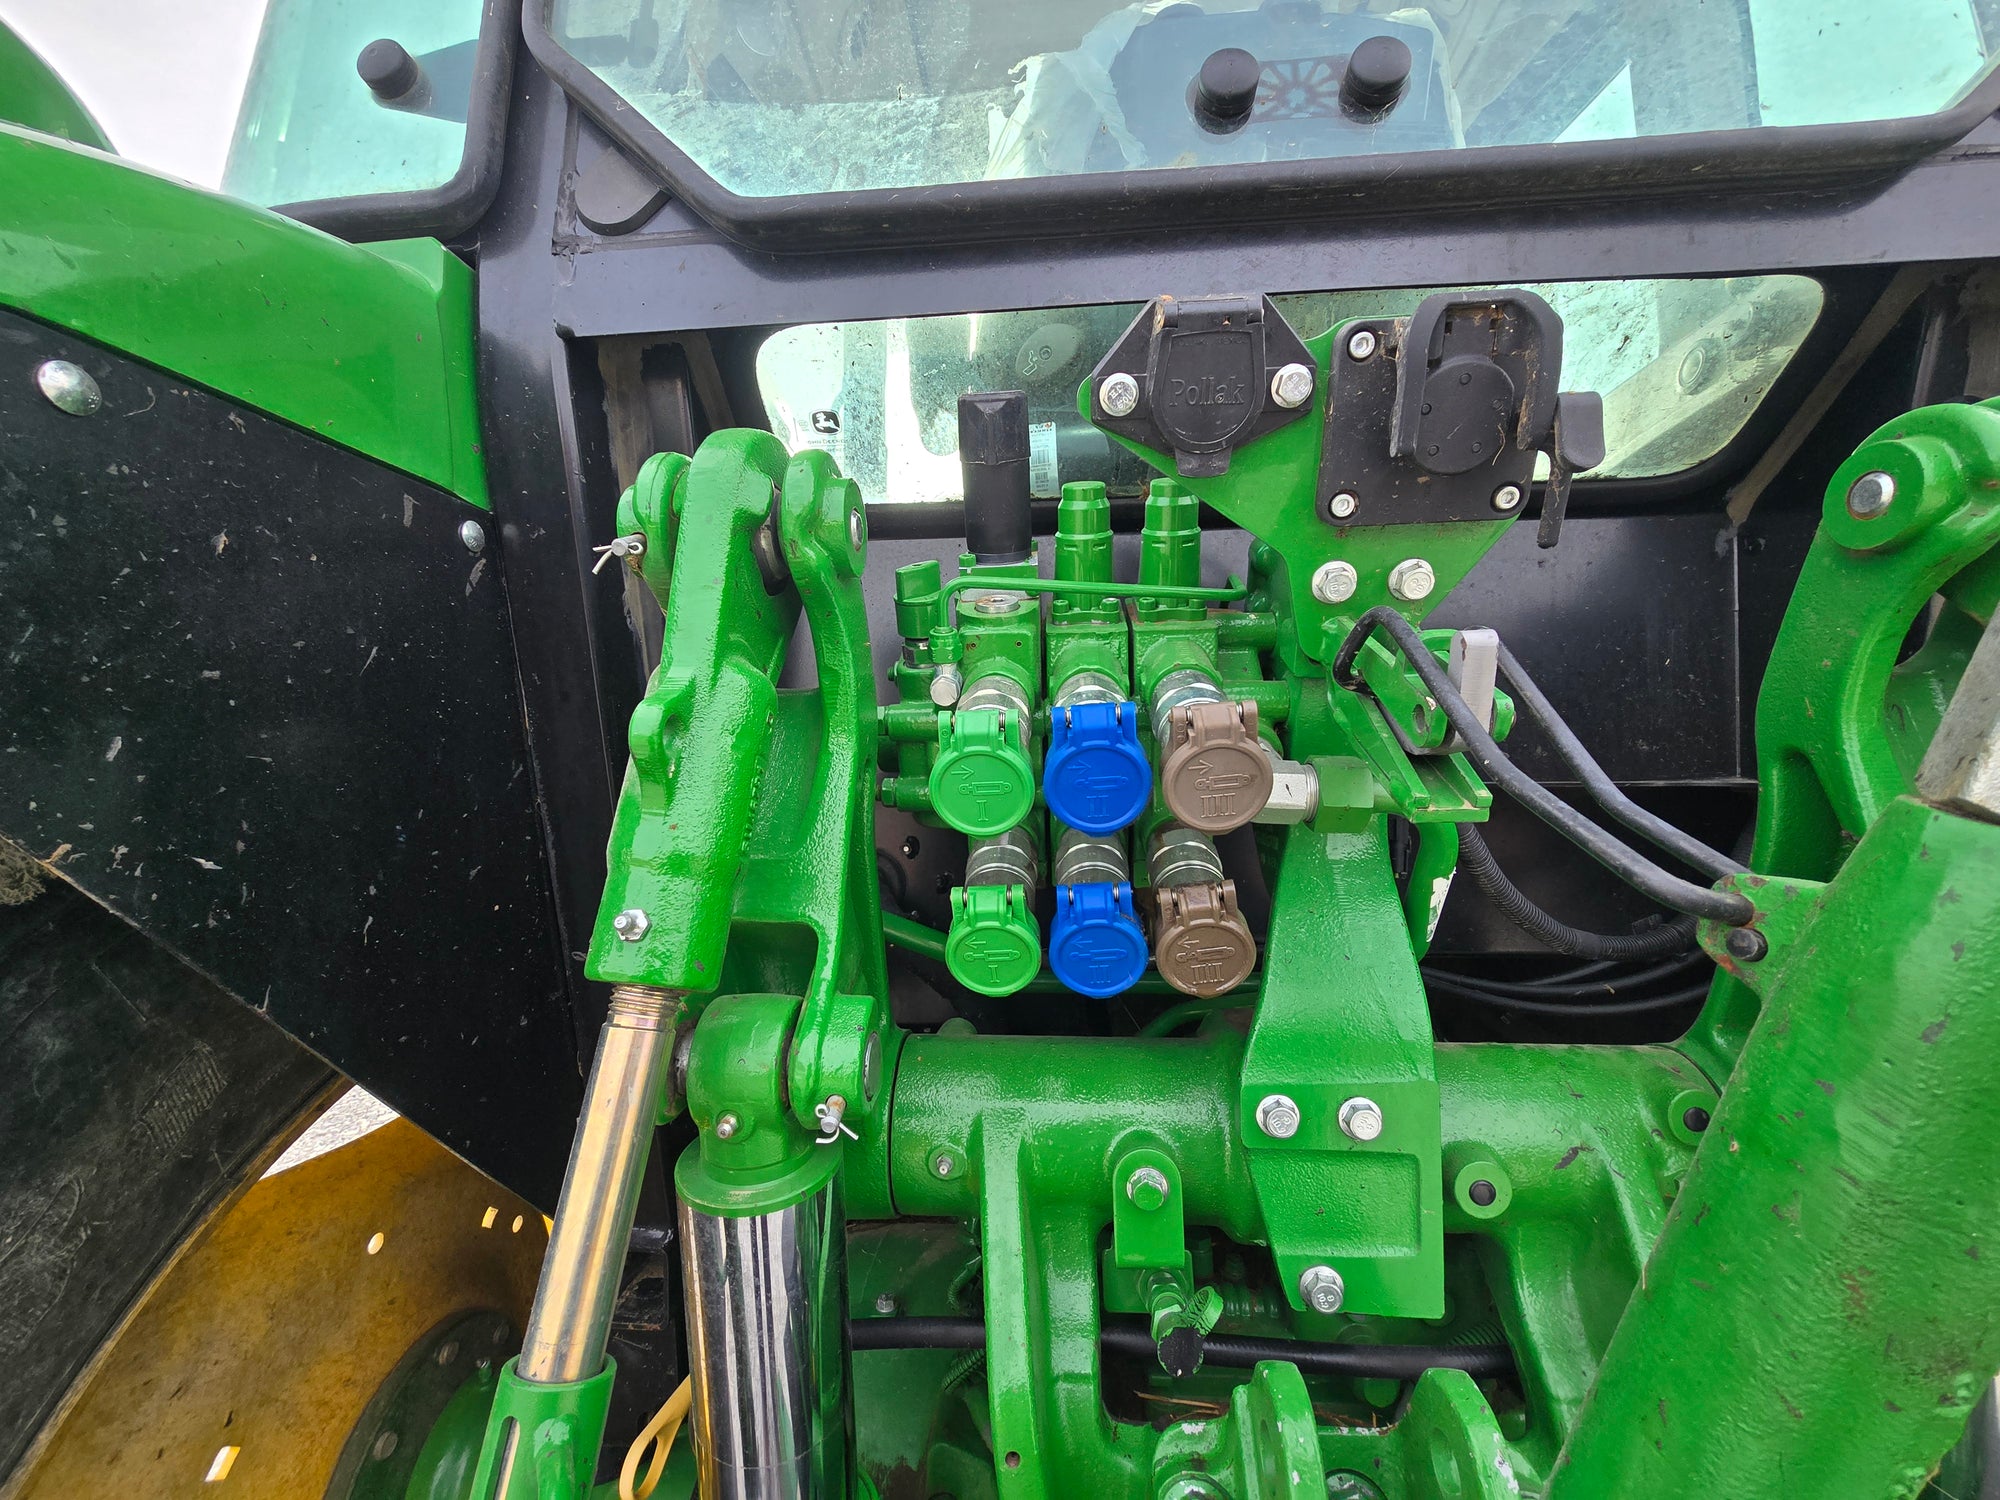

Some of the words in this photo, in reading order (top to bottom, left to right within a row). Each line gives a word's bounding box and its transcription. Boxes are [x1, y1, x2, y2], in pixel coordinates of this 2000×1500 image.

[1168, 374, 1245, 407] Pollak
[1087, 795, 1111, 818] II
[1200, 792, 1237, 818] III
[1088, 964, 1112, 985] II
[1191, 963, 1224, 985] III
